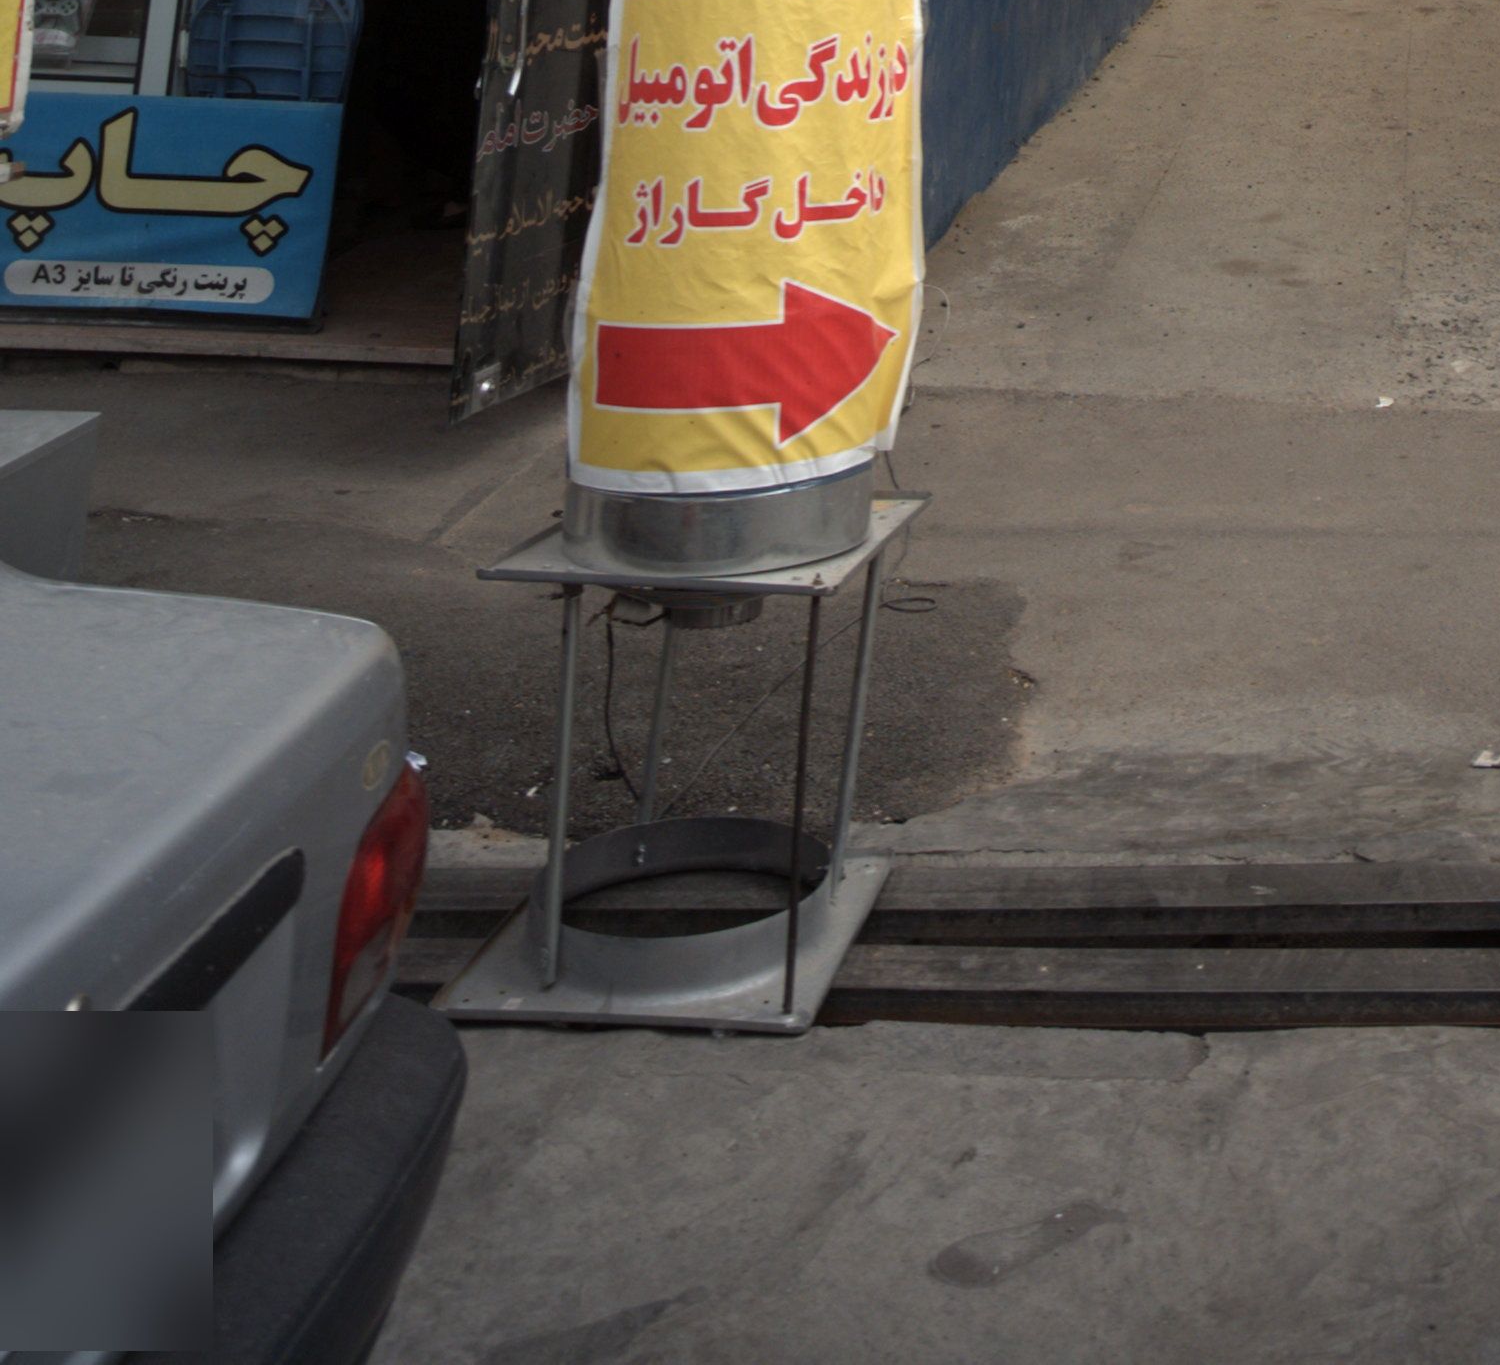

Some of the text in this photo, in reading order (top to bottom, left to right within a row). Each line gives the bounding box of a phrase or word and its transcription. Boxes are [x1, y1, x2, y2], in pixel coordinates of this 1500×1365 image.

[617, 34, 753, 131] اتومبیل
[0, 106, 314, 257] چاپ
[624, 168, 886, 246] داخل گاراژ
[31, 263, 249, 301] پرینت رنگی تا سایز A3
